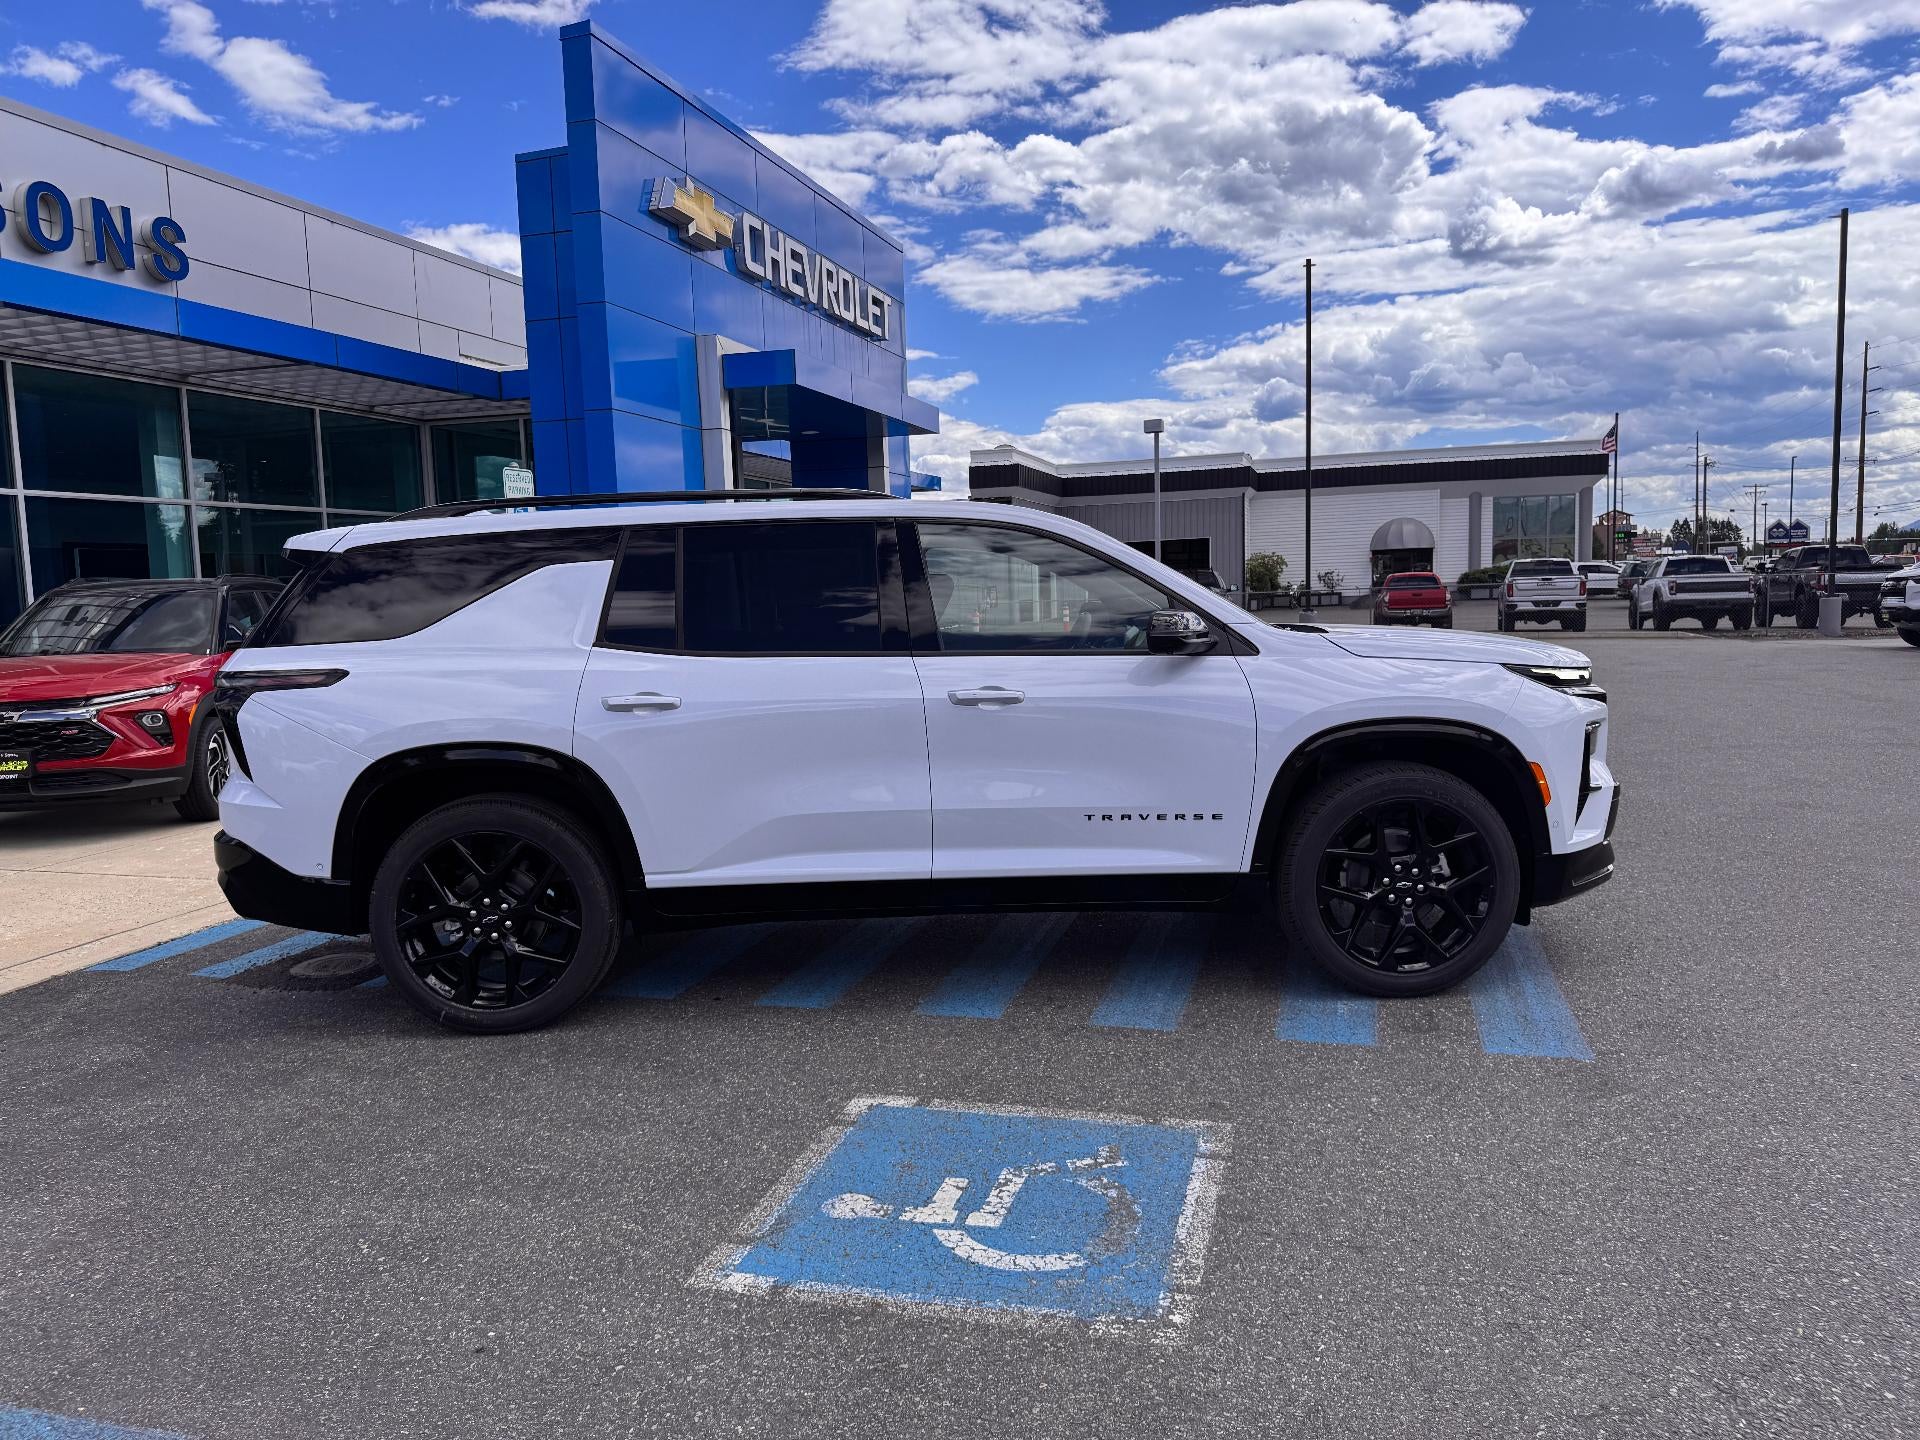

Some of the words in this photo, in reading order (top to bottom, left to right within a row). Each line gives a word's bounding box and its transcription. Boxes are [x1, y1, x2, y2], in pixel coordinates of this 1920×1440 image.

[0, 180, 189, 282] ONS
[738, 212, 892, 341] CHEVROLET
[1084, 813, 1224, 821] TRAVERSE
